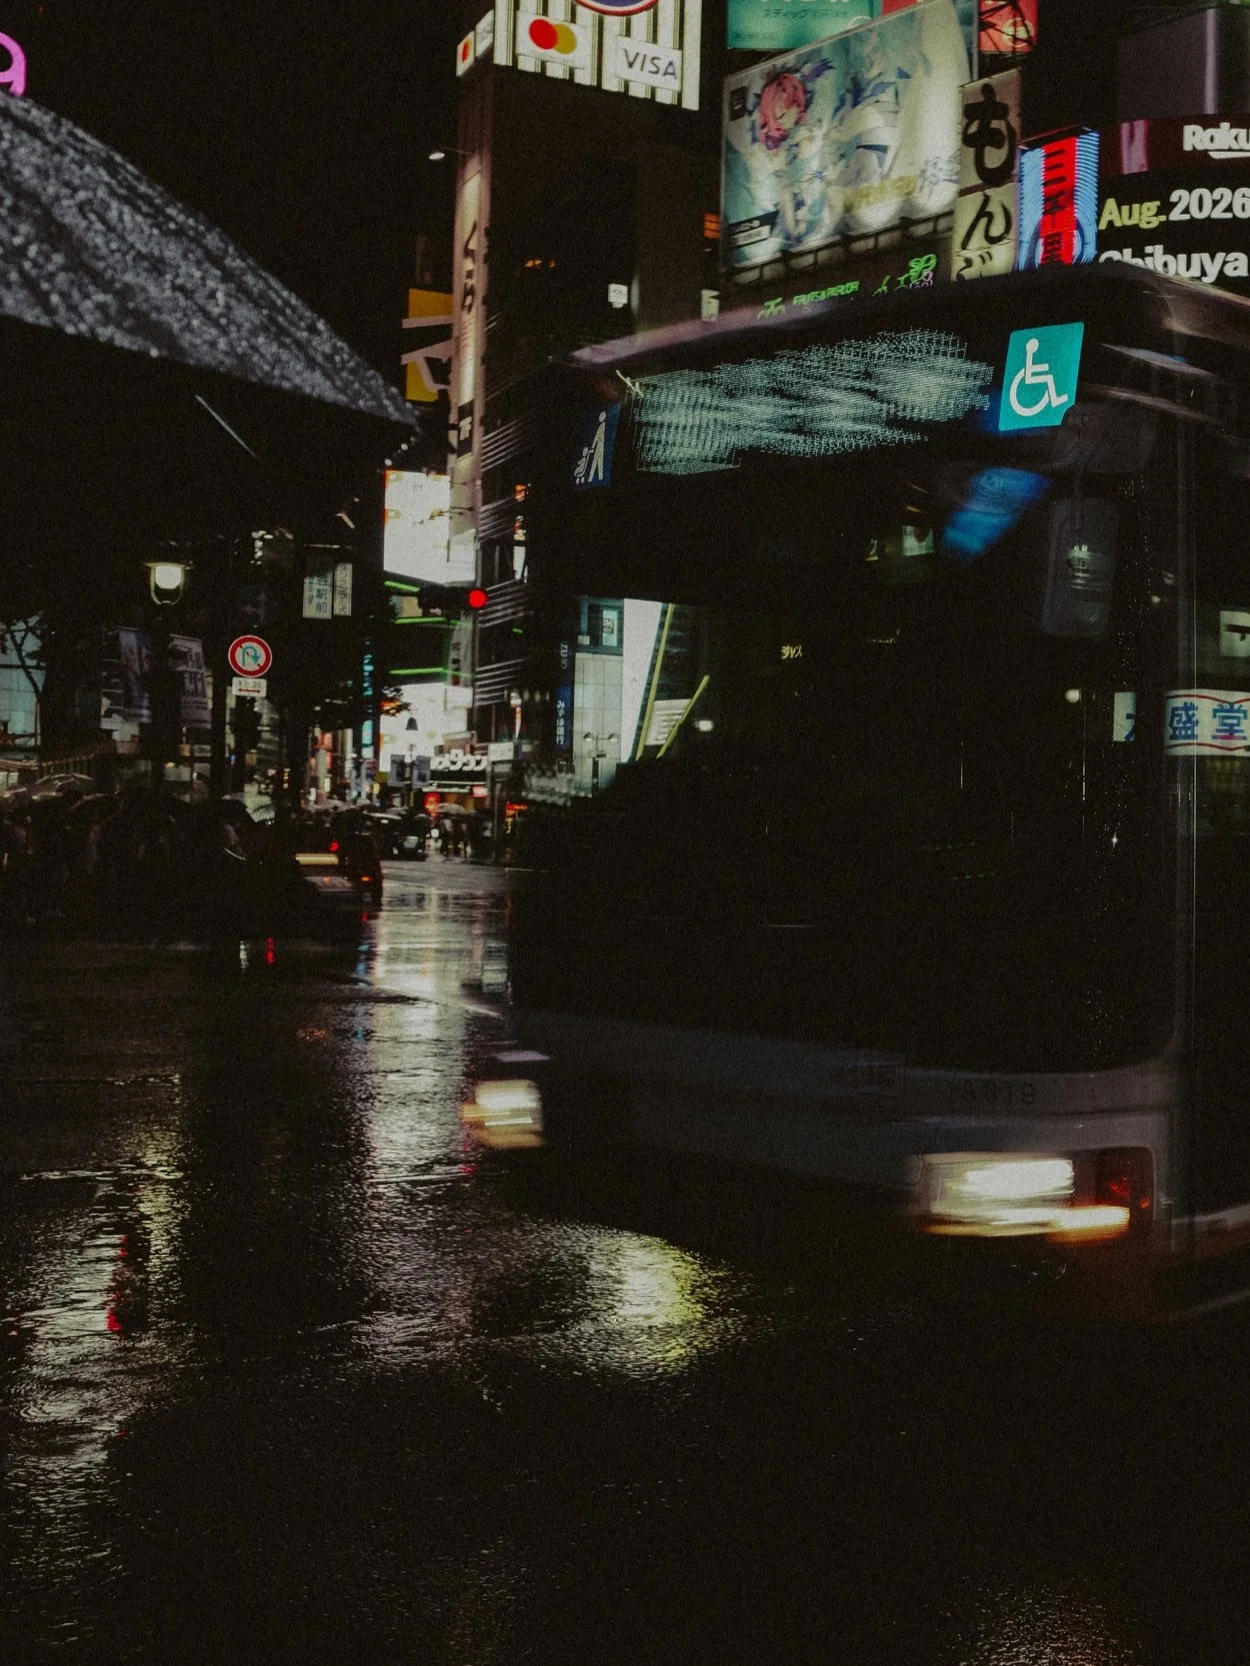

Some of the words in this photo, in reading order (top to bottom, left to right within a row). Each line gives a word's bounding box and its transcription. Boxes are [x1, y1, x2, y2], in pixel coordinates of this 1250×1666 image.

[623, 48, 678, 80] VISA
[1098, 198, 1168, 230] Aug.
[315, 574, 328, 613] 谷駅前
